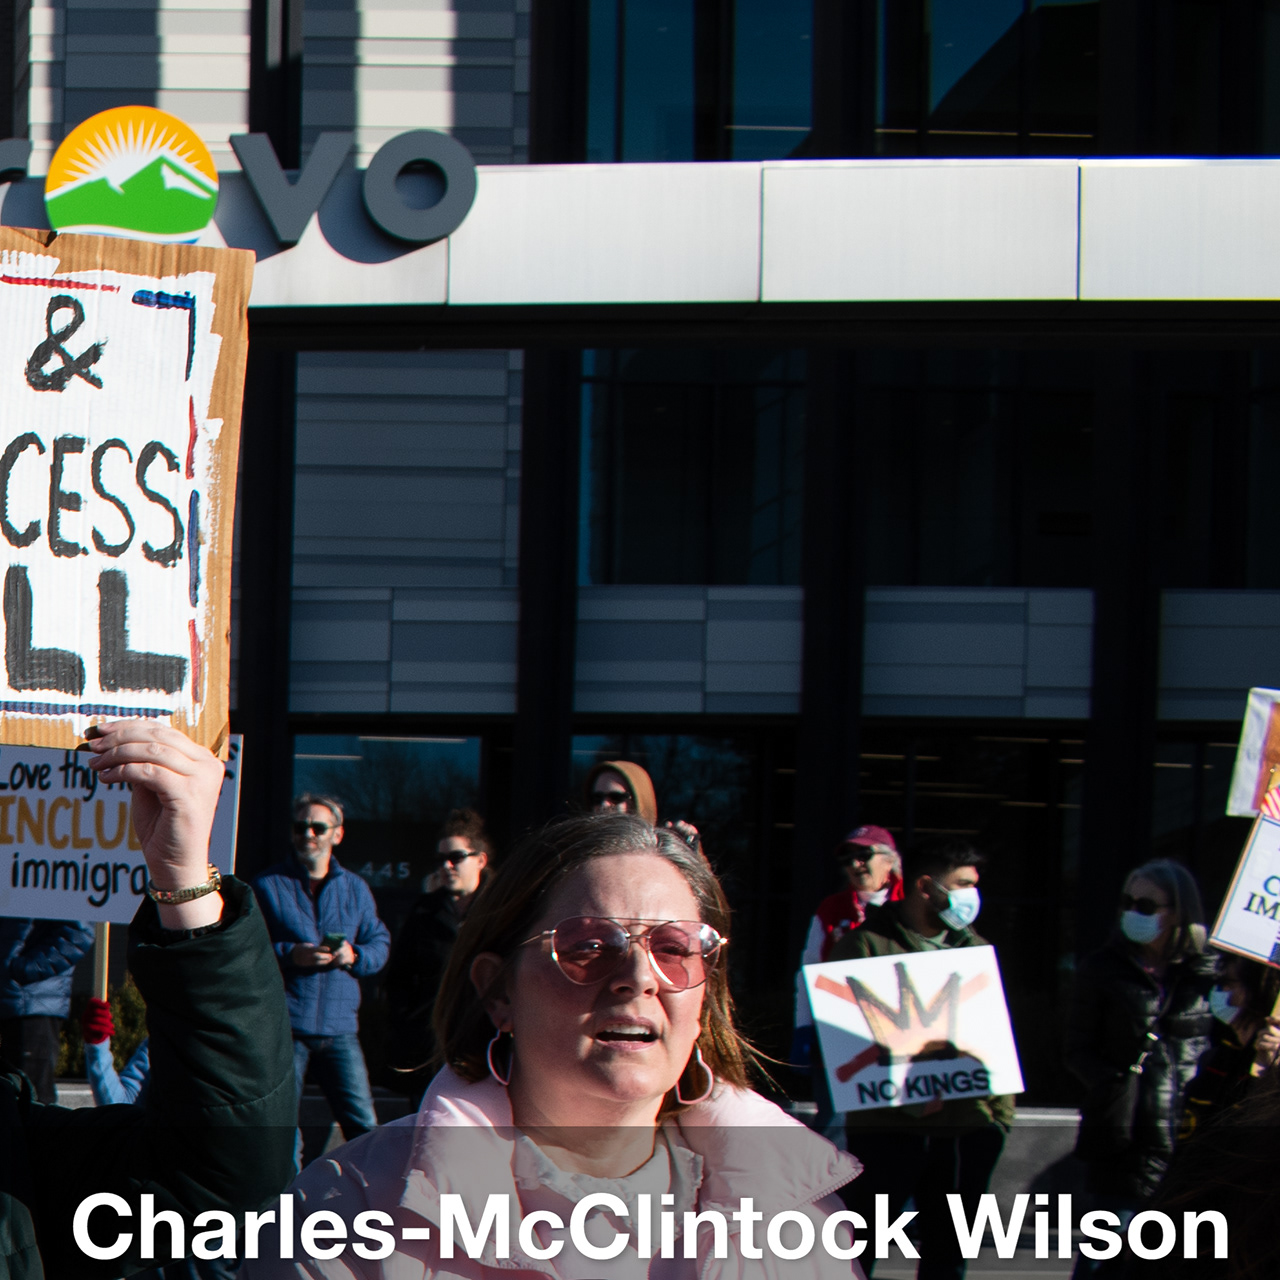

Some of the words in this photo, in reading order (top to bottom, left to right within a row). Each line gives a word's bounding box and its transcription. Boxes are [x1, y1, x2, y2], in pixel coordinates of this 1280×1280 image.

[25, 294, 109, 392] &
[59, 749, 99, 802] thy
[11, 851, 149, 907] immigra
[857, 1079, 901, 1105] NO
[905, 1070, 990, 1099] KINGS
